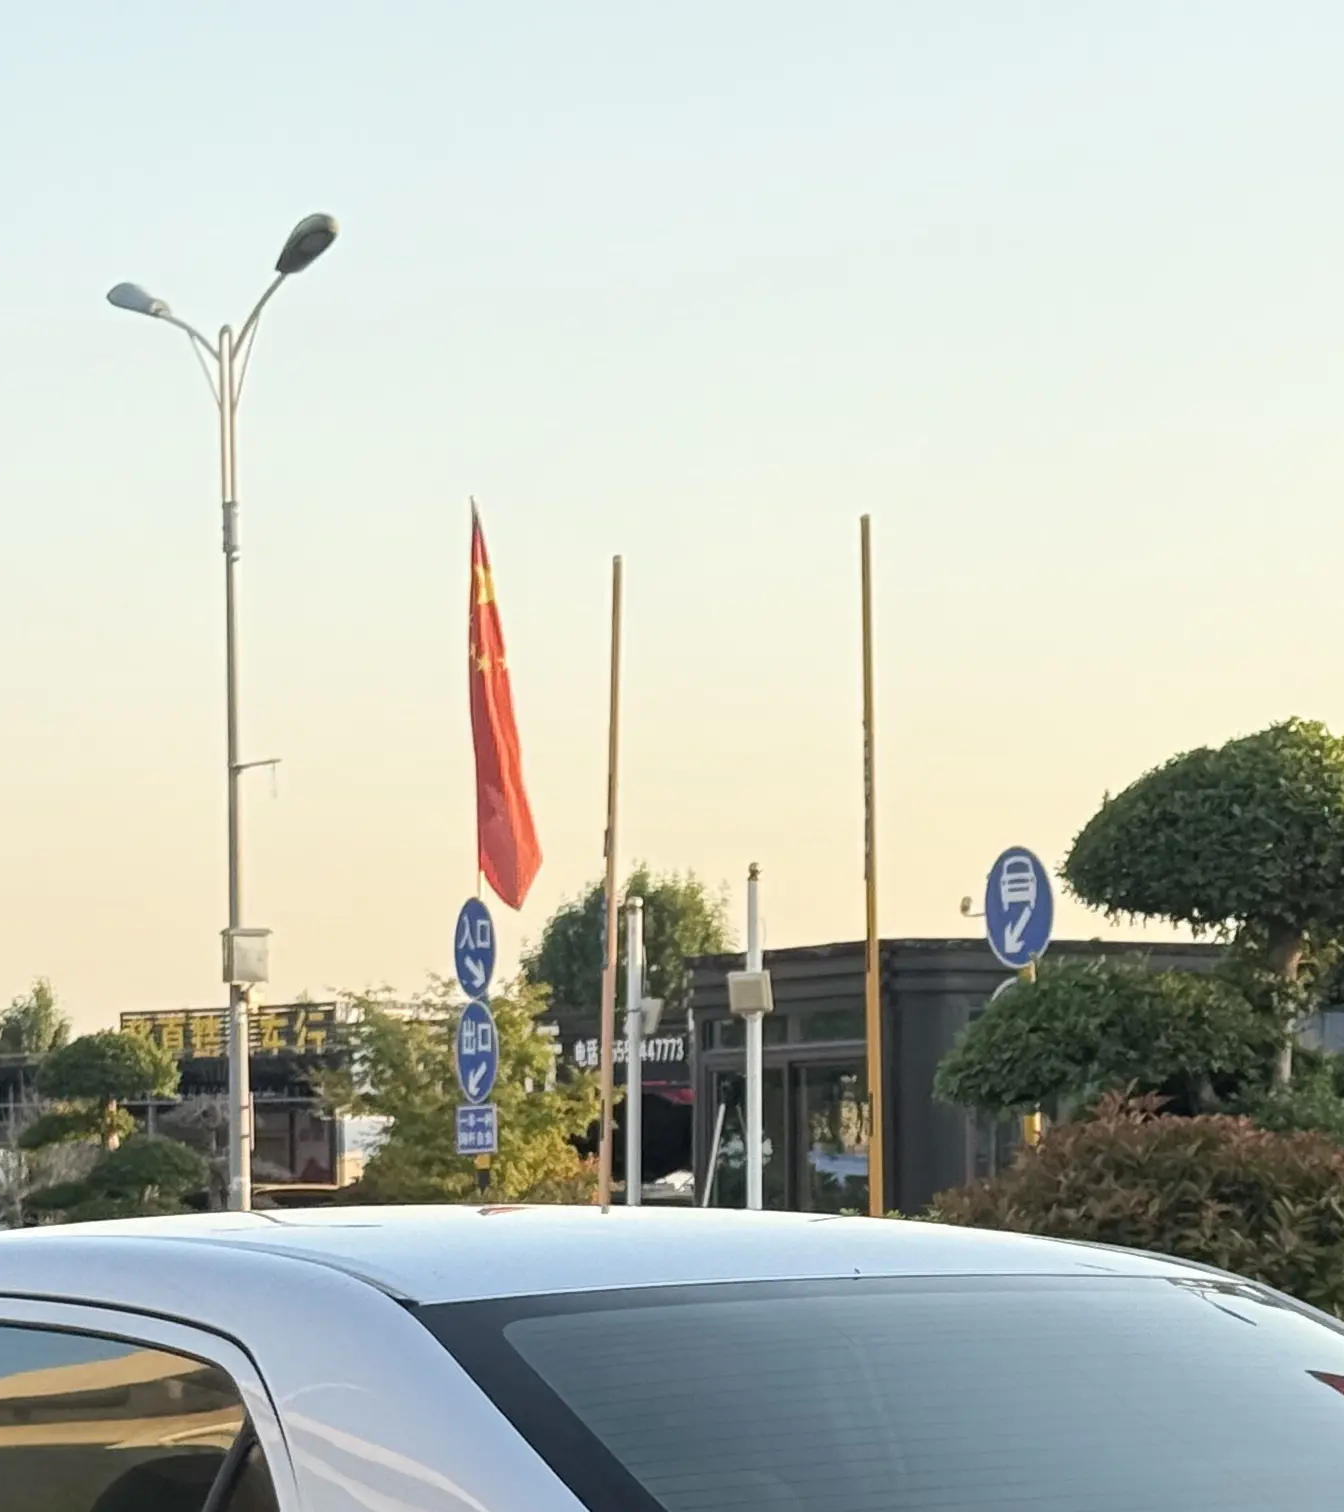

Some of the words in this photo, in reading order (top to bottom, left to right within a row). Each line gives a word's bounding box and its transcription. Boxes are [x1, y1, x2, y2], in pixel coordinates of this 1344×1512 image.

[459, 913, 491, 951] 入口
[461, 1017, 492, 1055] 出口
[575, 1038, 599, 1067] 电话
